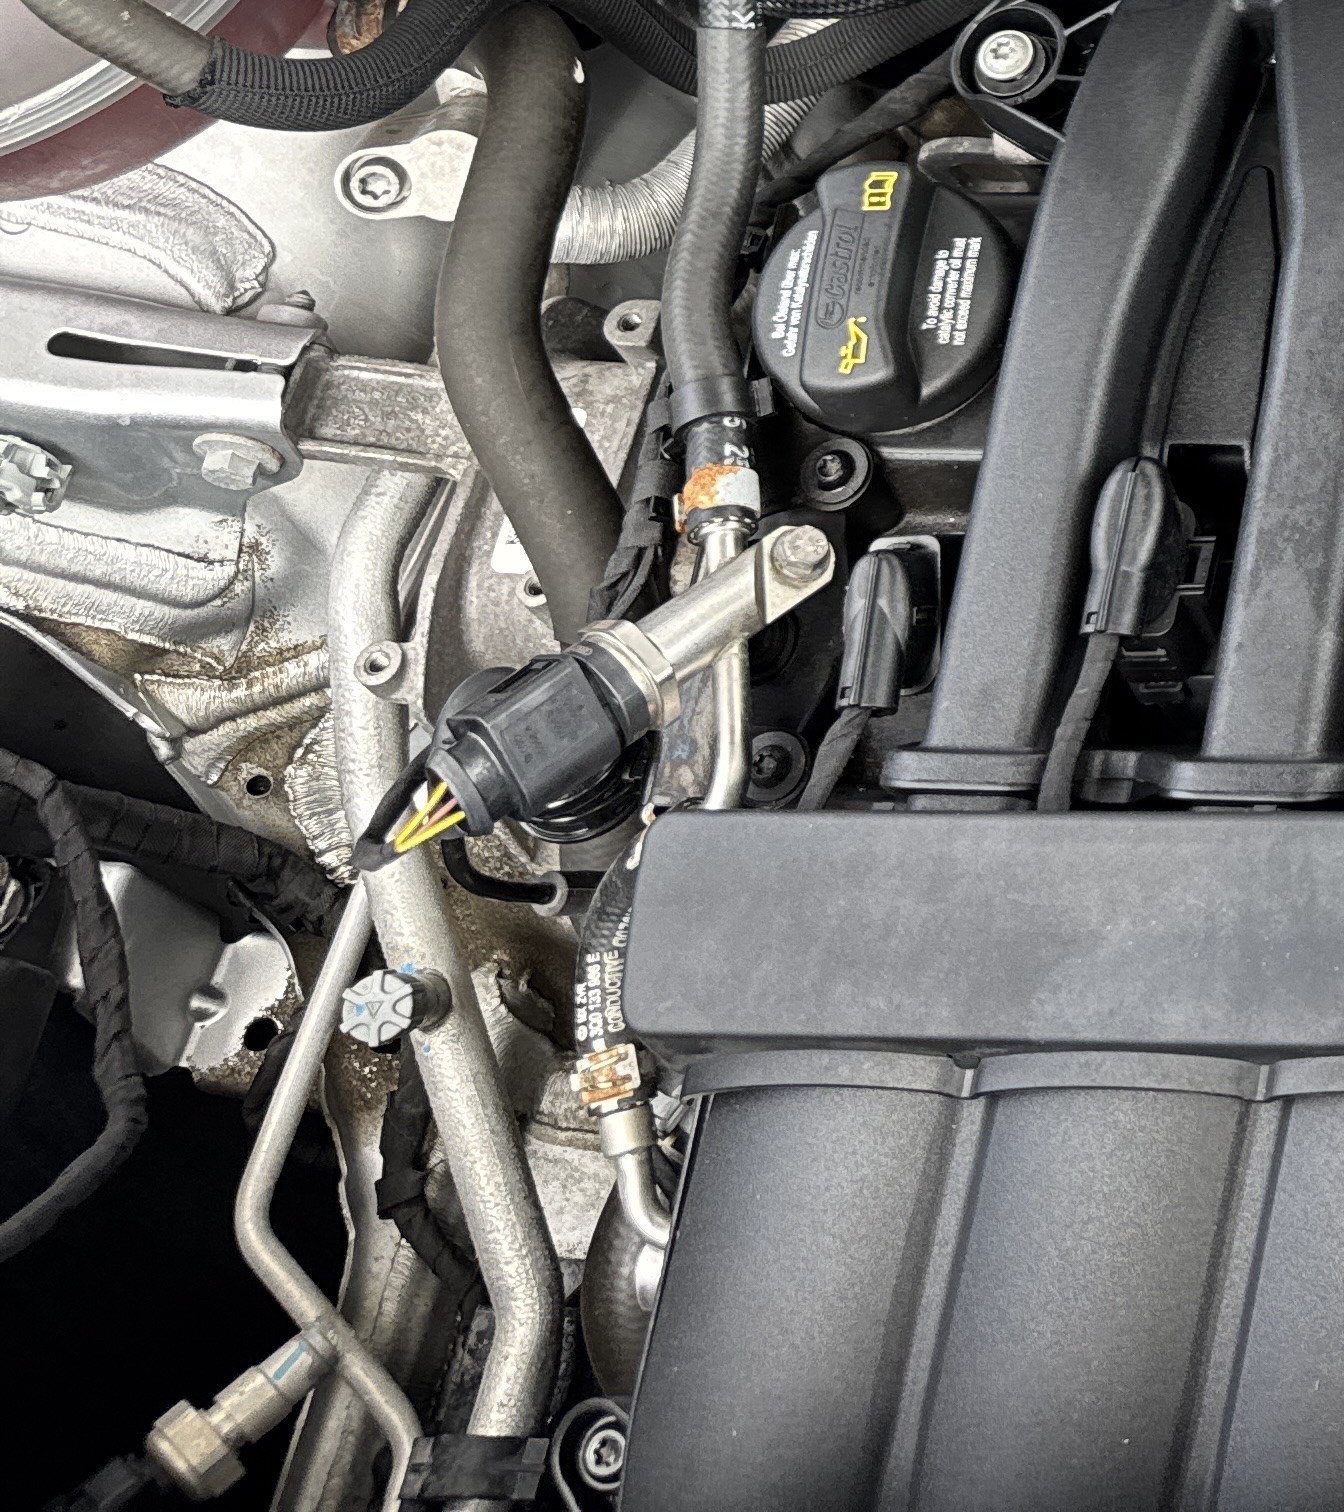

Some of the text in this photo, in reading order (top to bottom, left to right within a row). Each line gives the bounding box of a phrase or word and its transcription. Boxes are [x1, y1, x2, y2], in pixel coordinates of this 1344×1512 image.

[825, 224, 858, 301] Castrol
[929, 259, 949, 293] damage
[948, 258, 963, 270] oil
[926, 293, 941, 318] avoid
[943, 270, 960, 308] converter
[952, 237, 982, 346] not exceed maximum mark
[920, 317, 937, 330] To
[938, 307, 955, 345] catalytic
